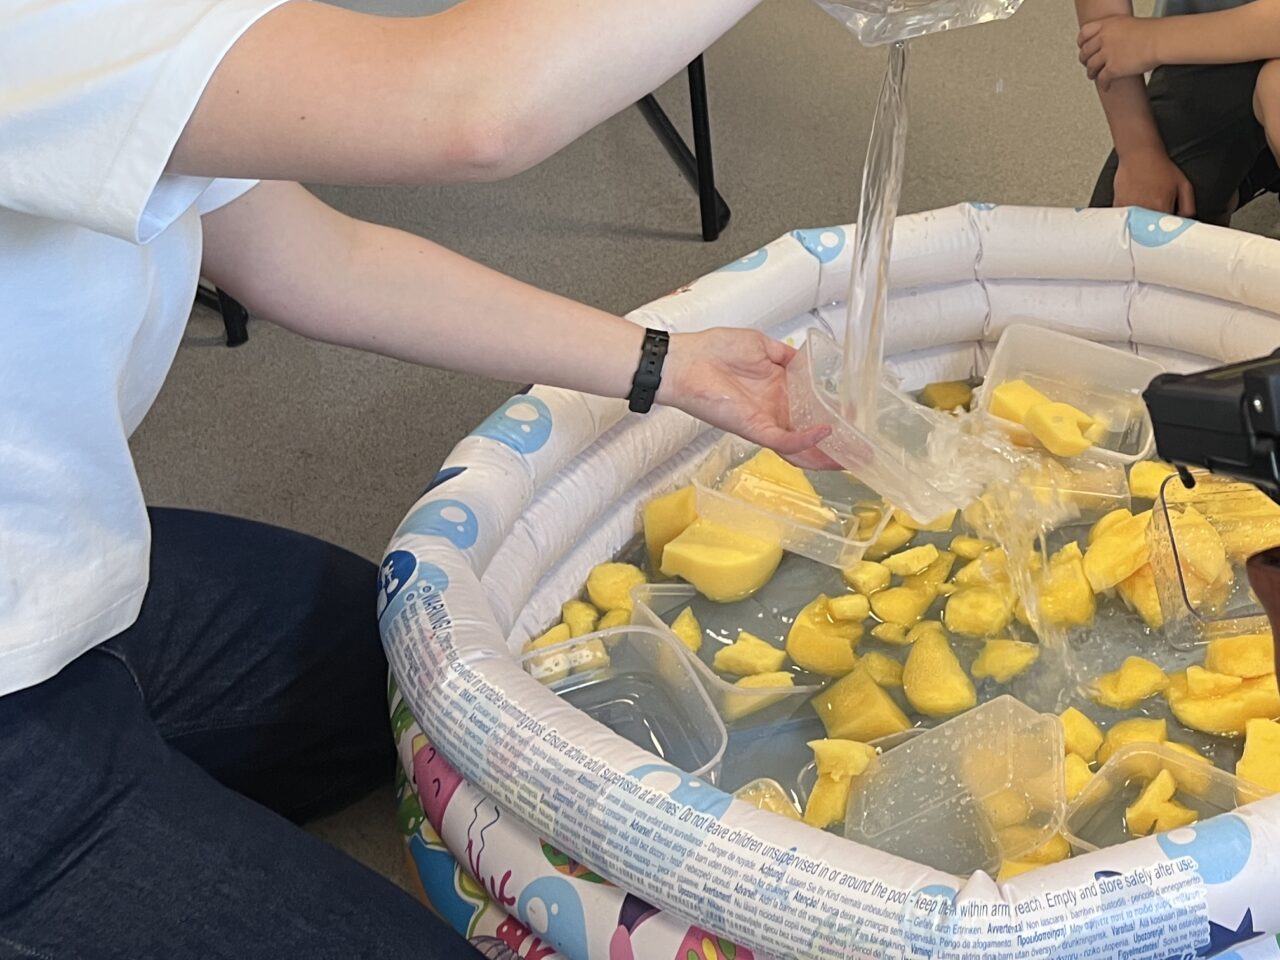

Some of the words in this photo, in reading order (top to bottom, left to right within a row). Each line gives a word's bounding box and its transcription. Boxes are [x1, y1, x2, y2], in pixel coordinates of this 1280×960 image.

[542, 729, 569, 753] Ensure
[564, 746, 588, 765] active
[600, 768, 642, 798] supervision
[679, 807, 694, 823] Do
[690, 813, 707, 829] not
[704, 819, 730, 840] leave
[728, 828, 764, 853] children
[762, 845, 820, 875] unsupervised
[818, 865, 829, 878] in
[829, 869, 841, 882] or
[839, 874, 874, 894] around
[871, 880, 888, 898] the
[885, 888, 910, 905] pool
[914, 894, 938, 917] keep
[960, 900, 988, 918] within
[991, 903, 1011, 918] arm
[1015, 896, 1046, 917] reach.
[1045, 890, 1077, 910] Empty
[1080, 883, 1098, 900] and
[1100, 879, 1124, 896] store
[1125, 869, 1153, 891] safely
[1155, 863, 1174, 880] after
[708, 842, 728, 858] Danger
[727, 850, 736, 860] de
[806, 881, 817, 893] Sie
[826, 889, 840, 902] Kind
[1026, 919, 1040, 930] Non
[820, 902, 840, 917] Nunca
